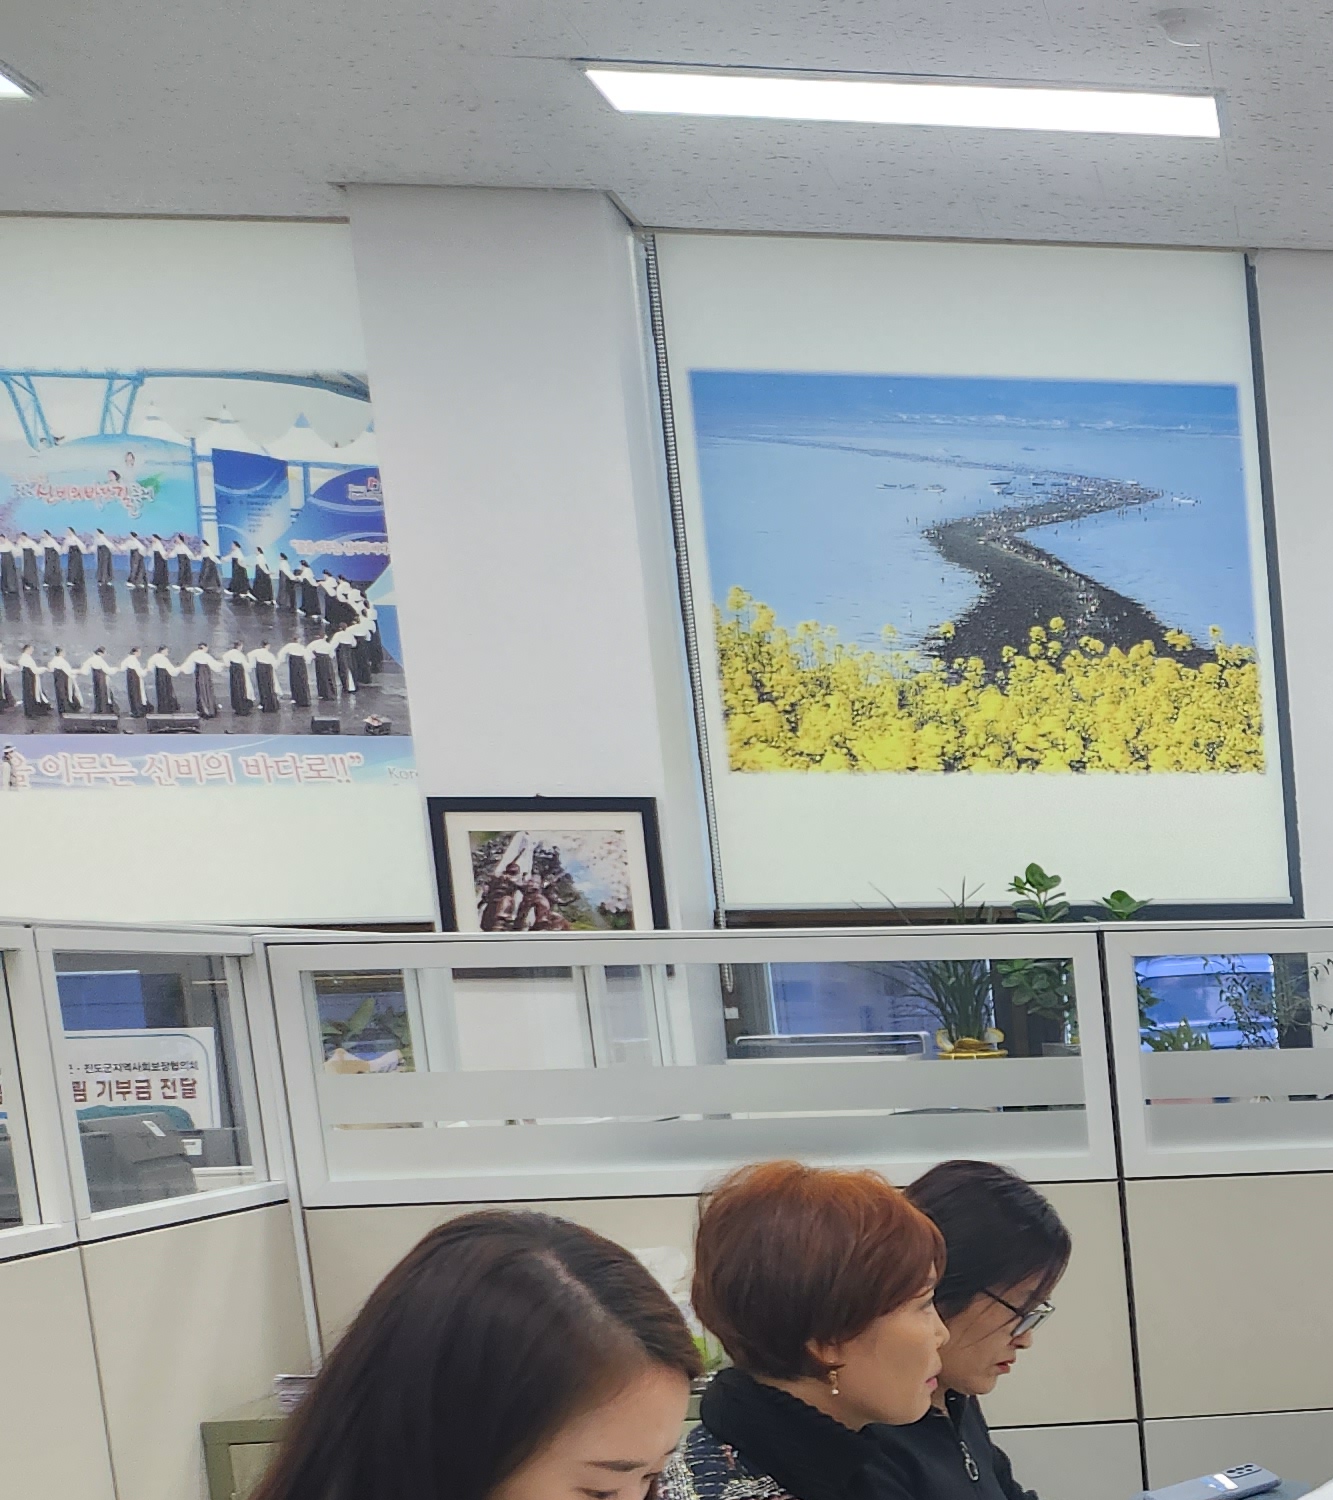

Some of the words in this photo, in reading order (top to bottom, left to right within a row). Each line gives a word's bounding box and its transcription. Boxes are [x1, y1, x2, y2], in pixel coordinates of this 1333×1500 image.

[41, 754, 137, 787] 이루는
[144, 754, 234, 787] 신비의
[96, 1079, 152, 1101] 기부금
[160, 1077, 197, 1099] 전달
